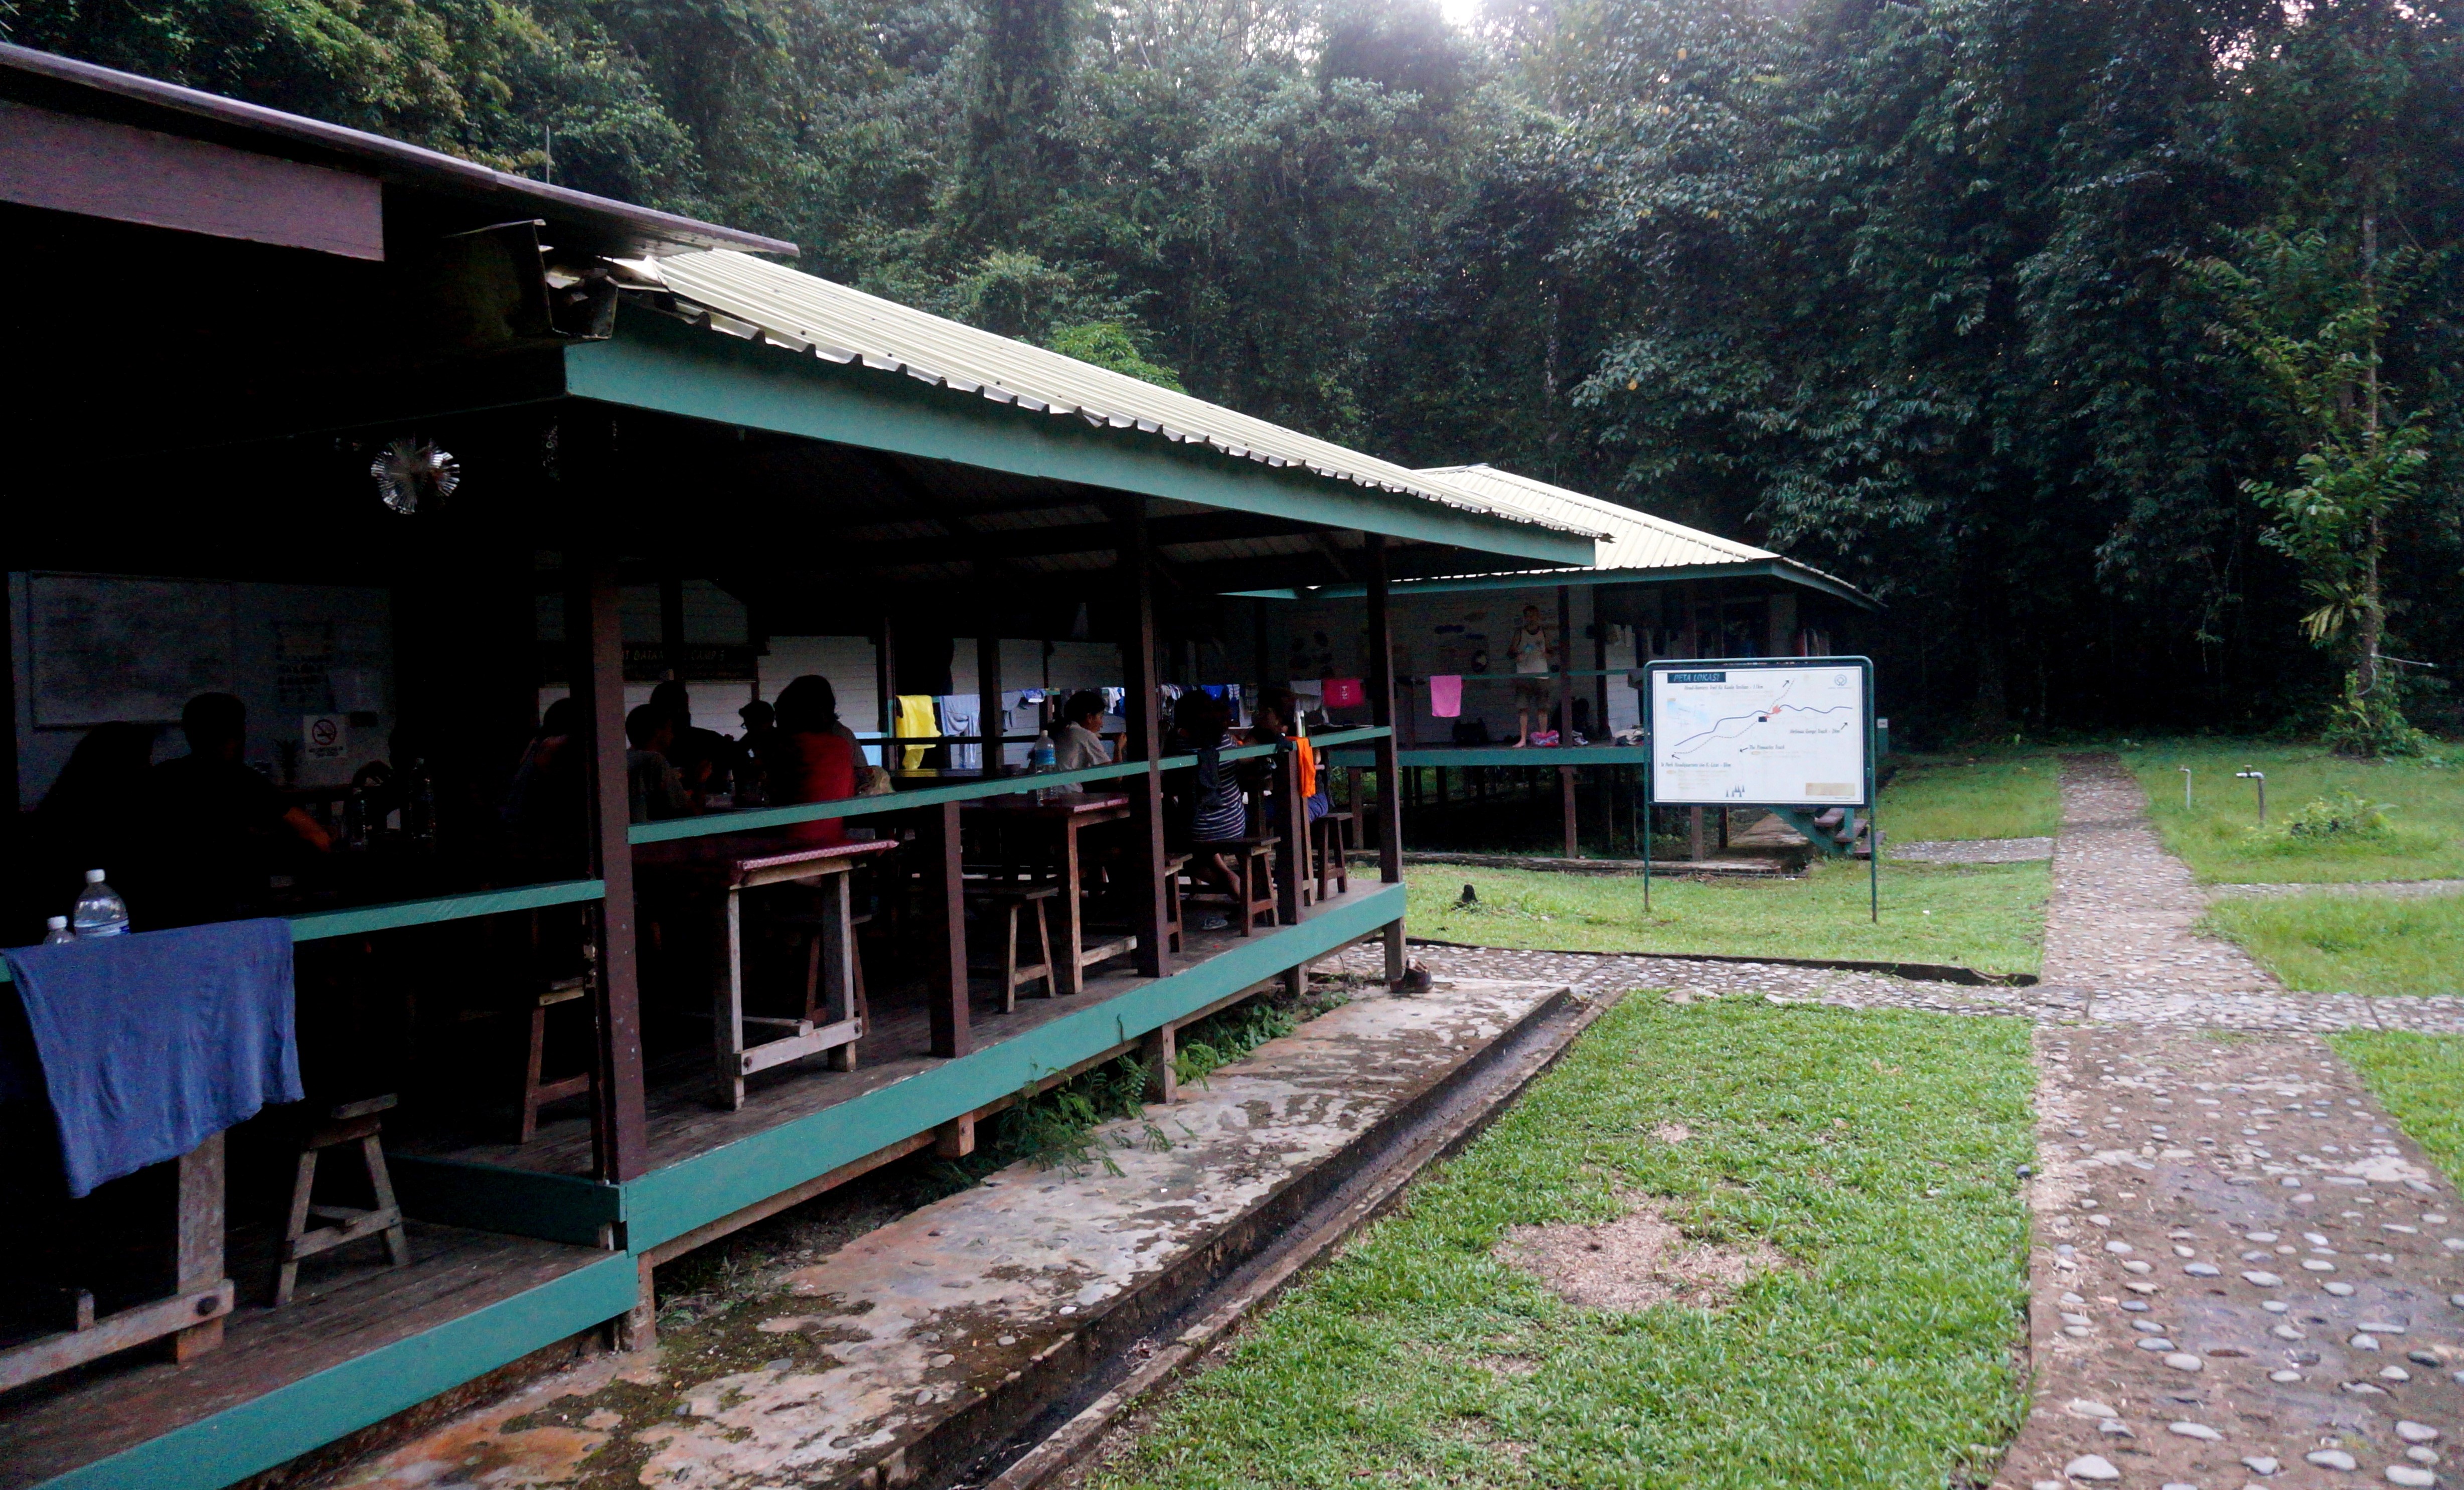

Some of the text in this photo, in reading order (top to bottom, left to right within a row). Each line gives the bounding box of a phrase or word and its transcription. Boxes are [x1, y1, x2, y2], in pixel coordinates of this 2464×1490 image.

[691, 650, 716, 661] CAMP
[1673, 673, 1720, 682] PETA LOKASI
